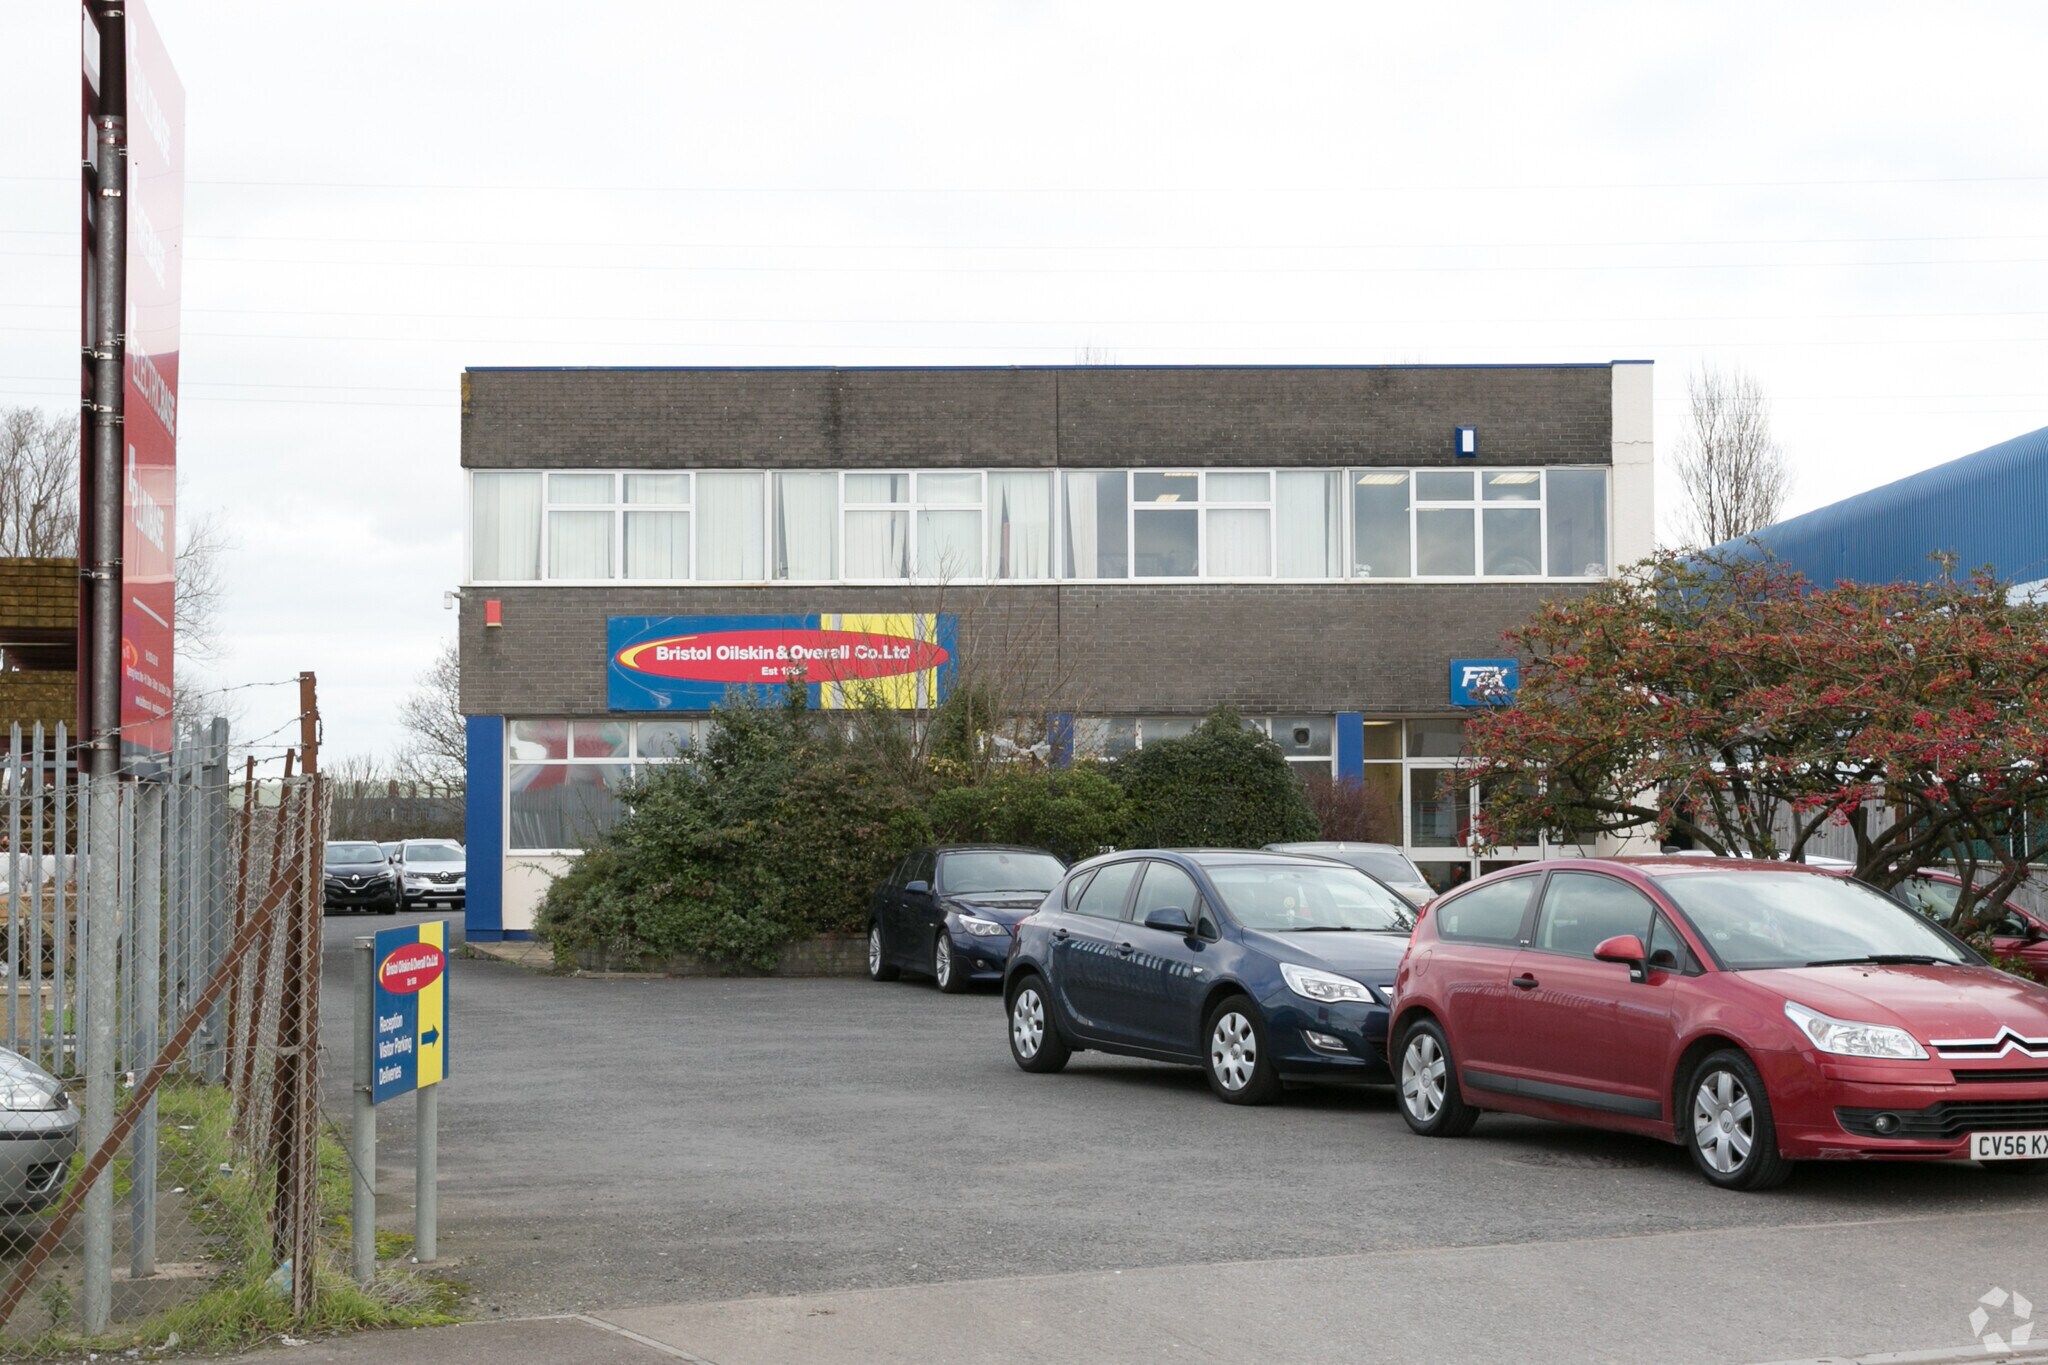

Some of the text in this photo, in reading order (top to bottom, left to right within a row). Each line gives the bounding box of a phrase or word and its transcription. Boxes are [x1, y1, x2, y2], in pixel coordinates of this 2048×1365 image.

[656, 646, 711, 660] Bristol
[716, 645, 774, 660] Oilskin
[776, 645, 788, 660] &
[789, 645, 850, 660] Overall
[761, 666, 778, 676] Est
[380, 1012, 403, 1034] Reception
[379, 1035, 412, 1059] Visitor Parking
[379, 1063, 402, 1085] Deliveries
[1979, 1136, 2026, 1156] CV56
